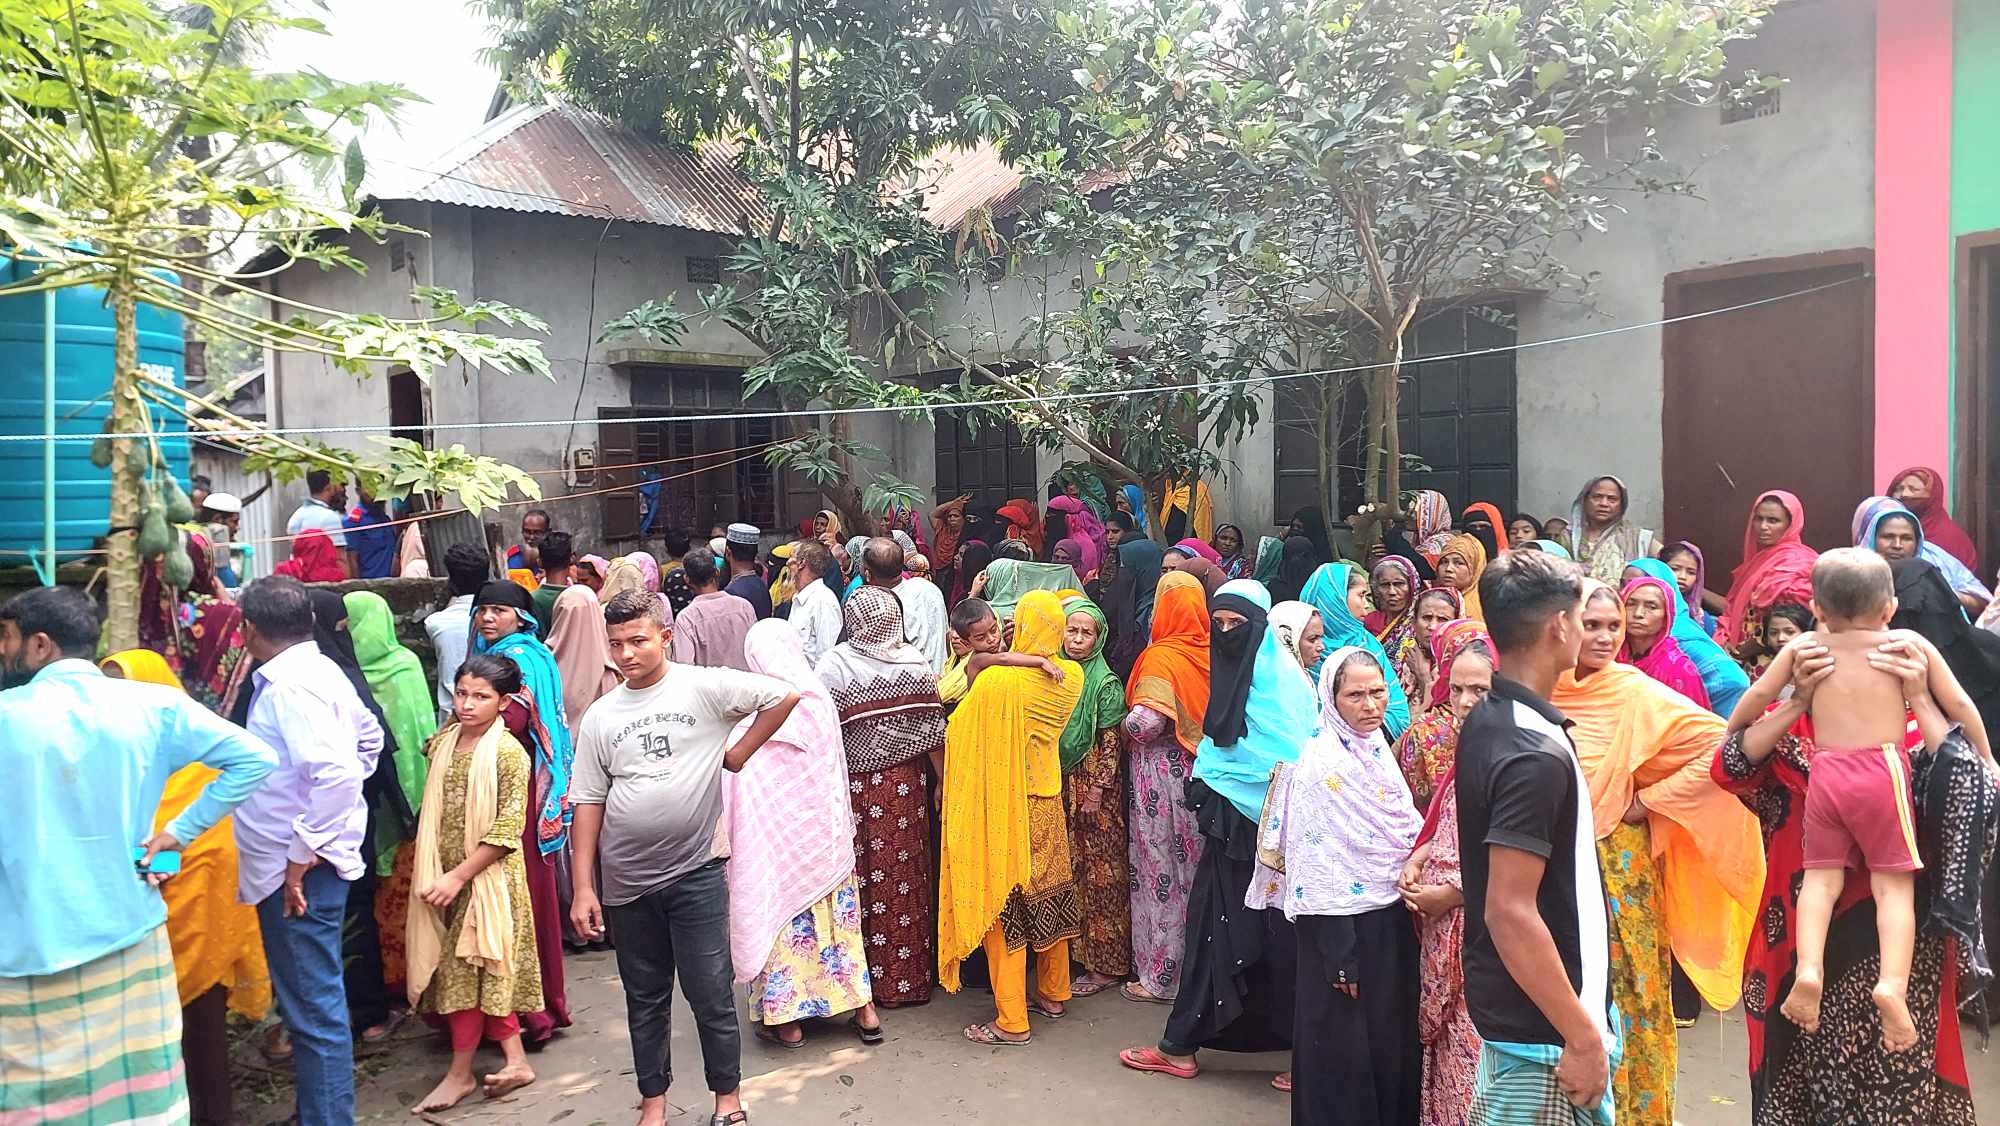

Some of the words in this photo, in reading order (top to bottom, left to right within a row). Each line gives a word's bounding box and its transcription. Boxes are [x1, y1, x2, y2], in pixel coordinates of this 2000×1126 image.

[612, 715, 652, 748] VENICE
[655, 713, 697, 726] BEACH
[638, 732, 673, 761] LA
